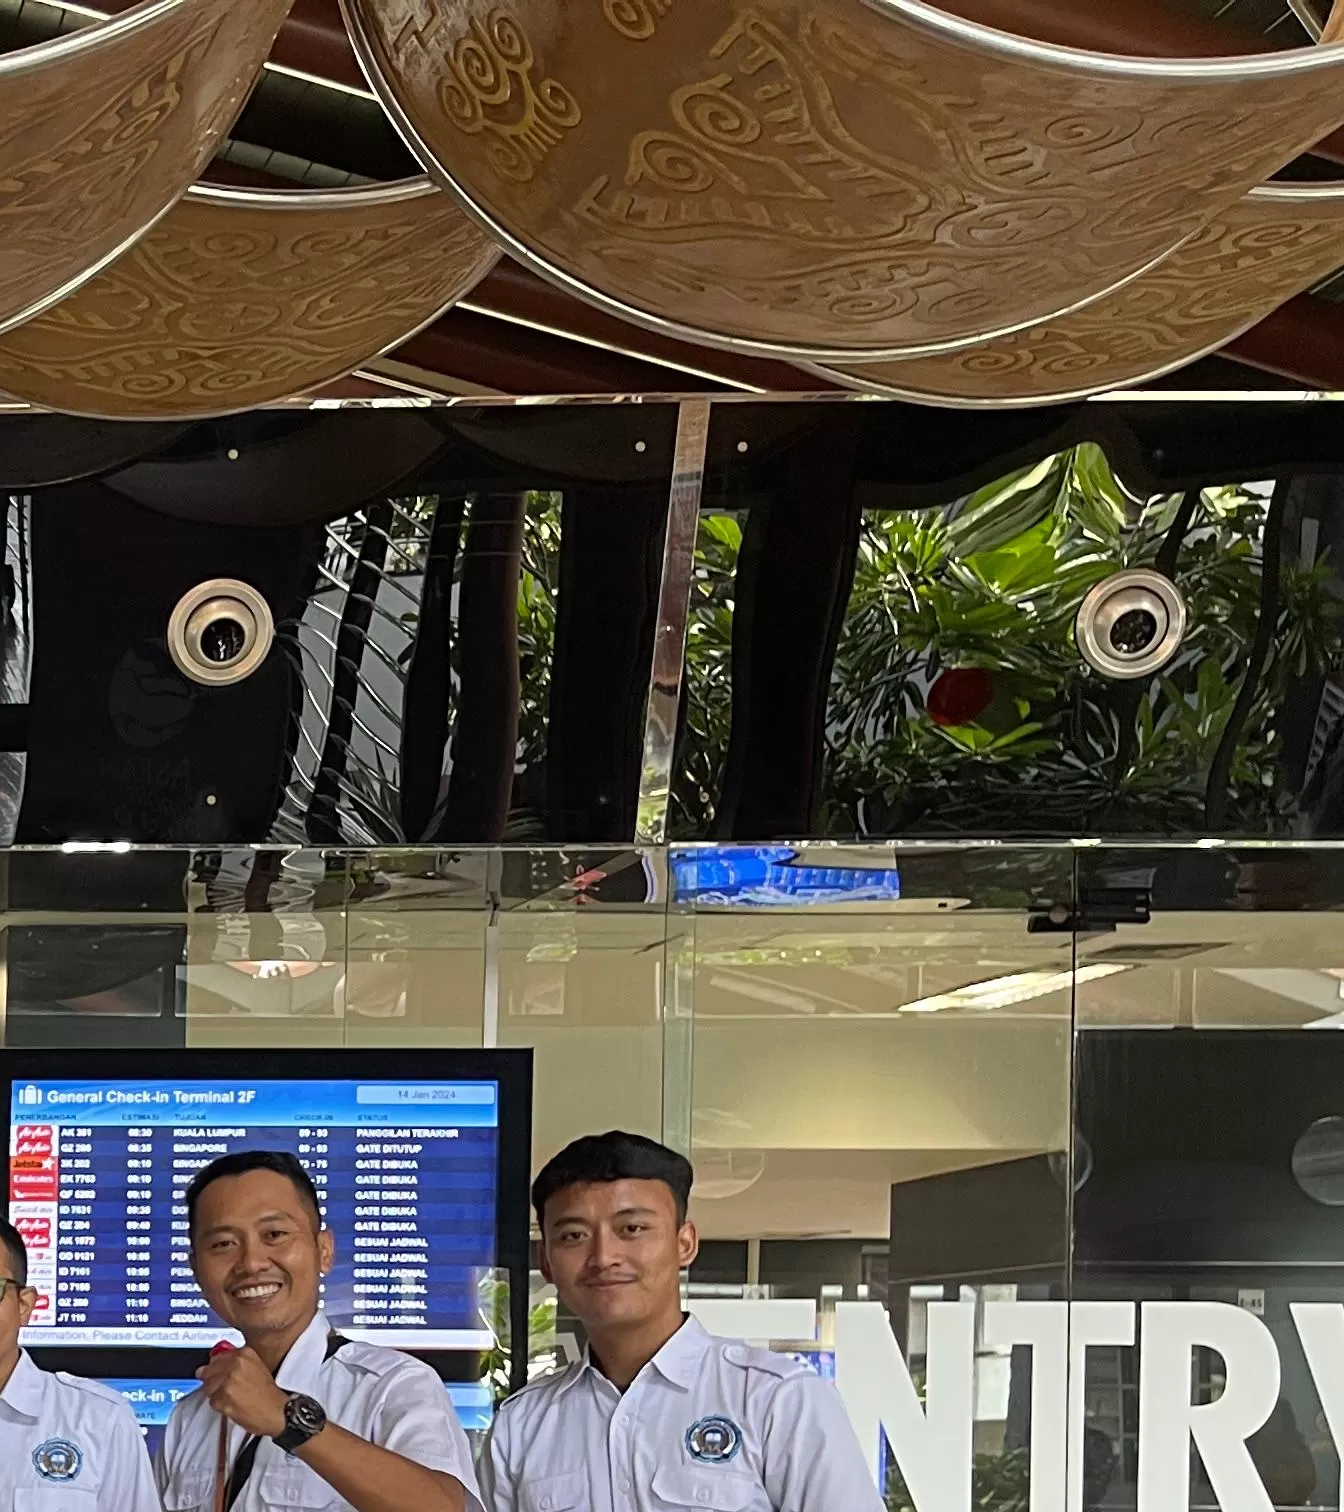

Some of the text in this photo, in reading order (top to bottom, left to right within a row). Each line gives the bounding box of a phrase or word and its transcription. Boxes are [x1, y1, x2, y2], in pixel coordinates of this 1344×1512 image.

[47, 1089, 256, 1104] General Check-in Terminal 2F
[411, 1090, 430, 1099] Jan
[356, 1144, 380, 1154] GATE
[356, 1160, 380, 1170] GATE
[355, 1175, 380, 1184] GATE
[355, 1191, 380, 1200] GATE
[355, 1206, 380, 1216] GATE
[354, 1222, 380, 1231] GATE
[92, 1330, 132, 1340] Please
[134, 1331, 179, 1341] Contact
[182, 1331, 218, 1341] Airline
